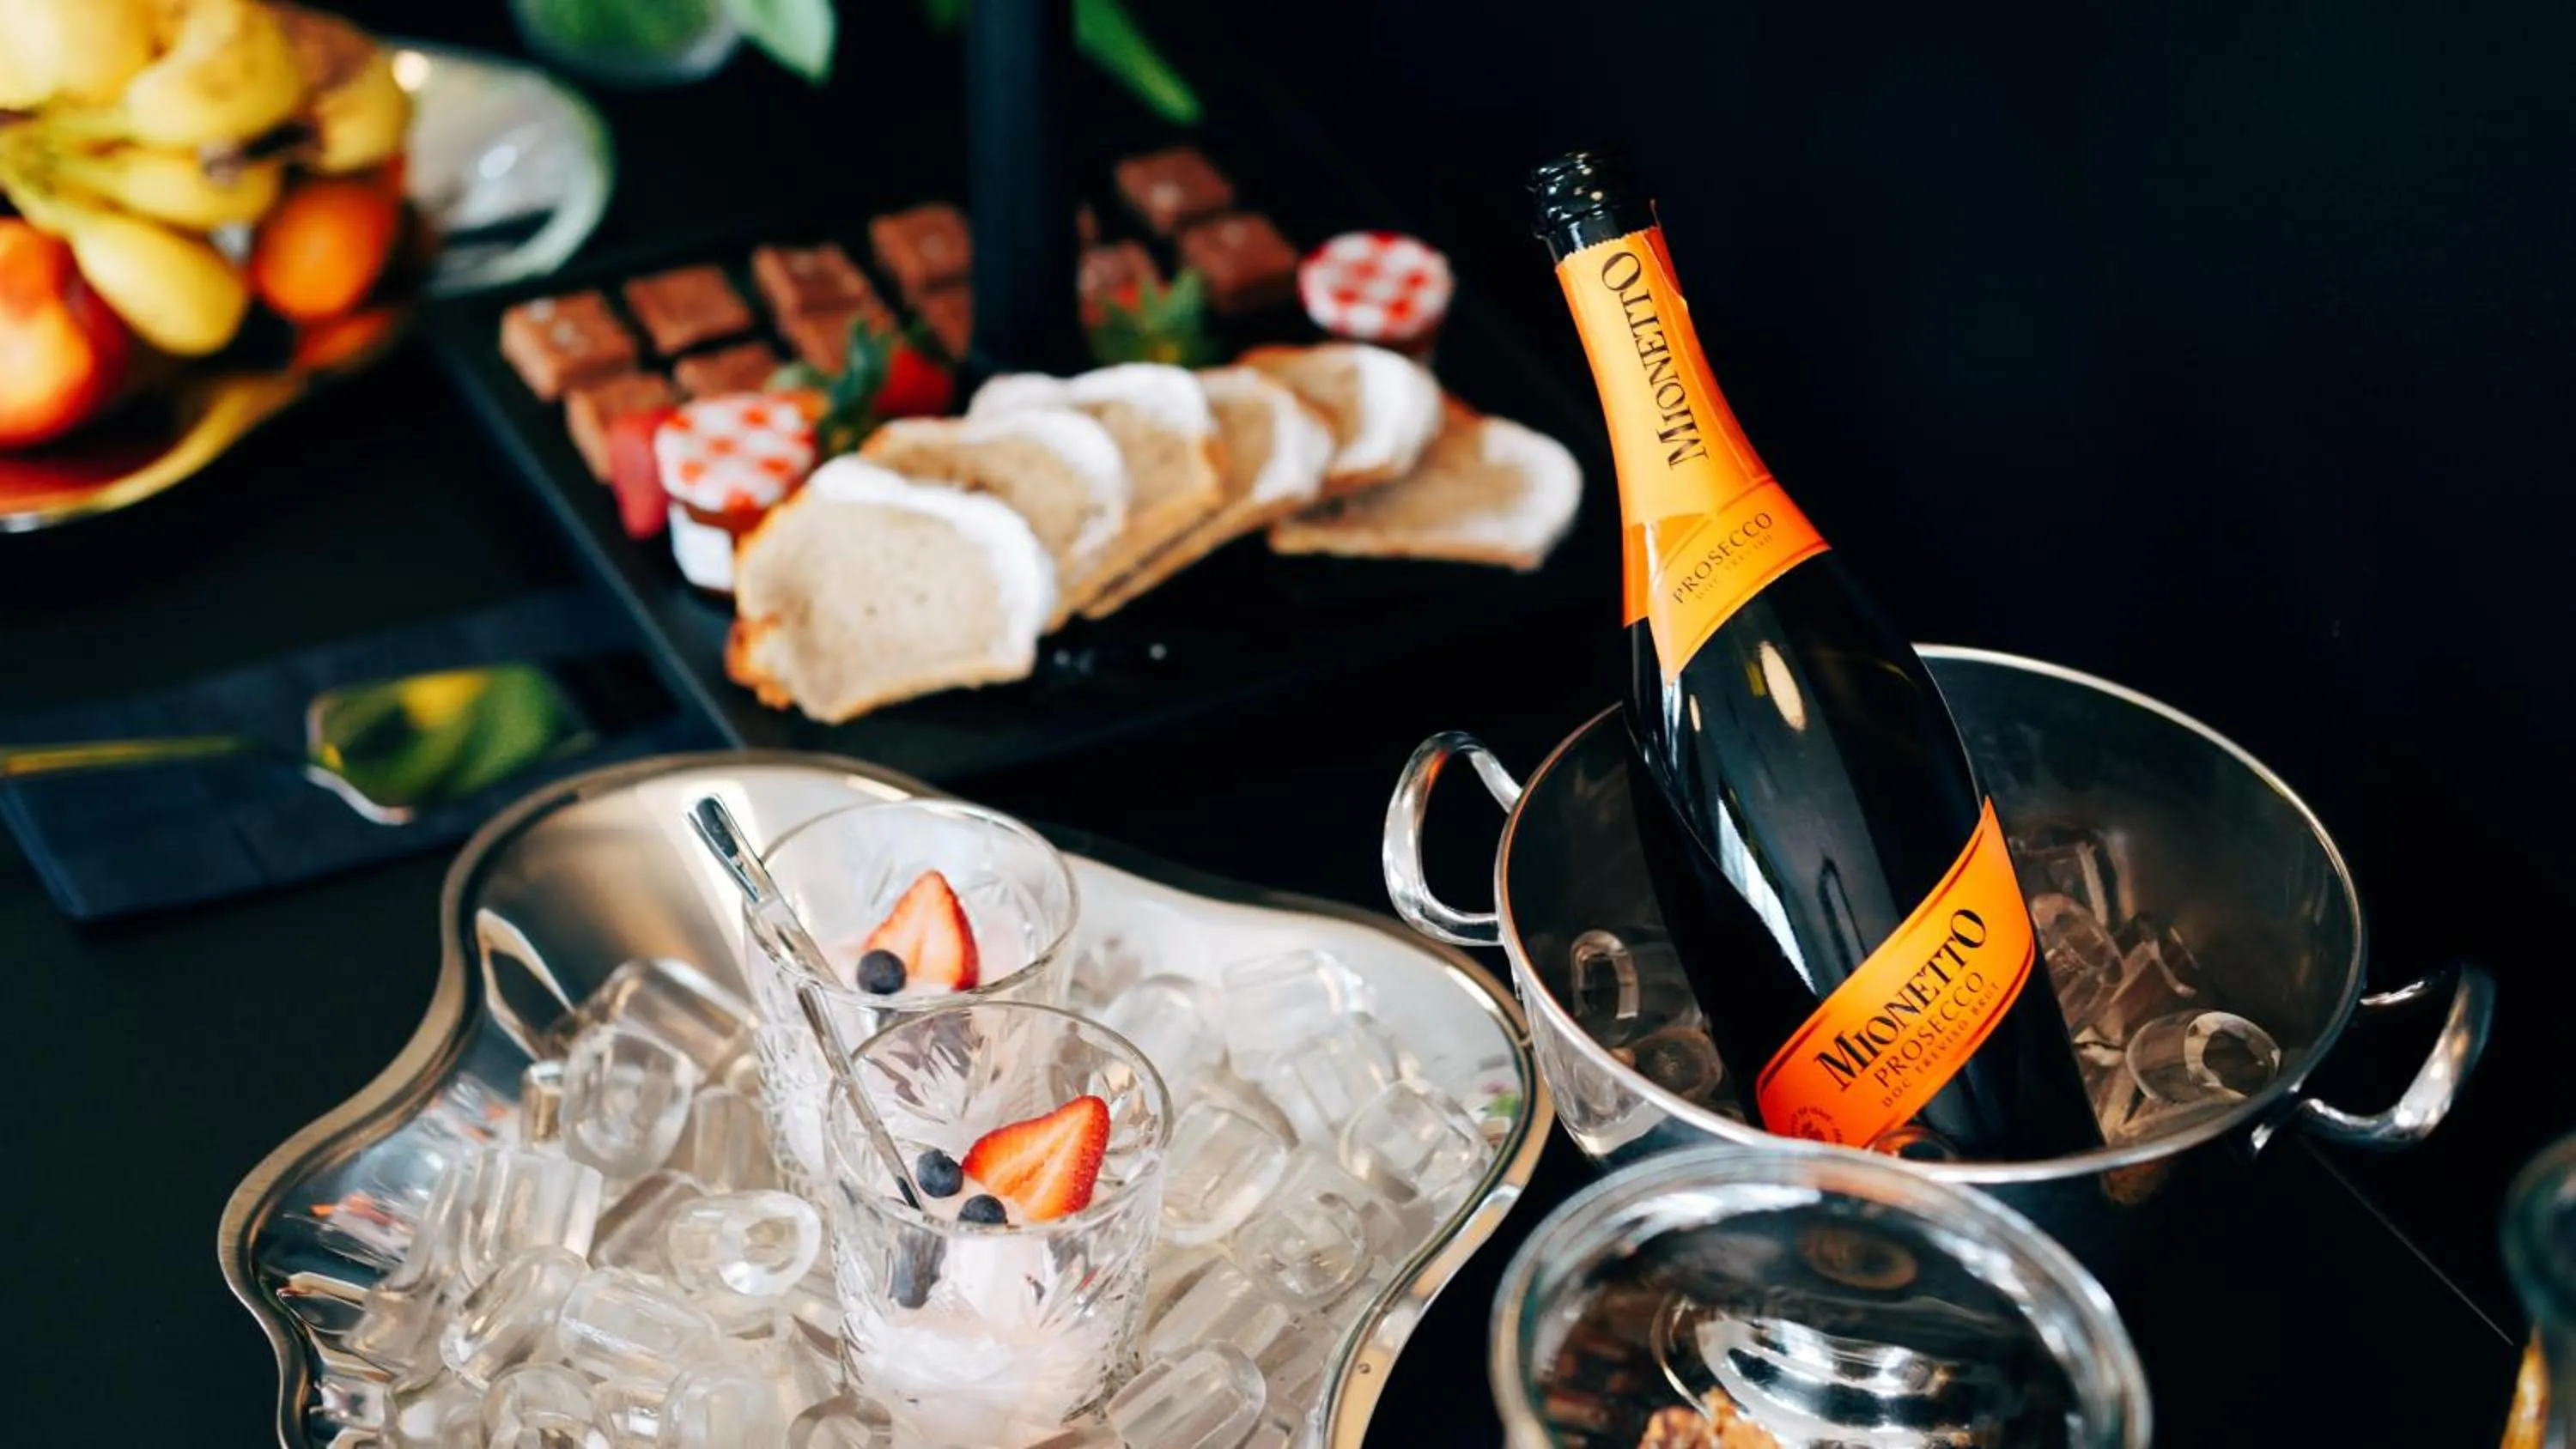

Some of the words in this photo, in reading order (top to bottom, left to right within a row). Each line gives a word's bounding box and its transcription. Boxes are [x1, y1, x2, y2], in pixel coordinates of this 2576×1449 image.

[1601, 252, 1709, 470] MIONETTO
[1673, 512, 1772, 603] PROSECCO
[1814, 909, 1986, 1092] MIONETTO
[1874, 973, 1984, 1087] PROSECCO
